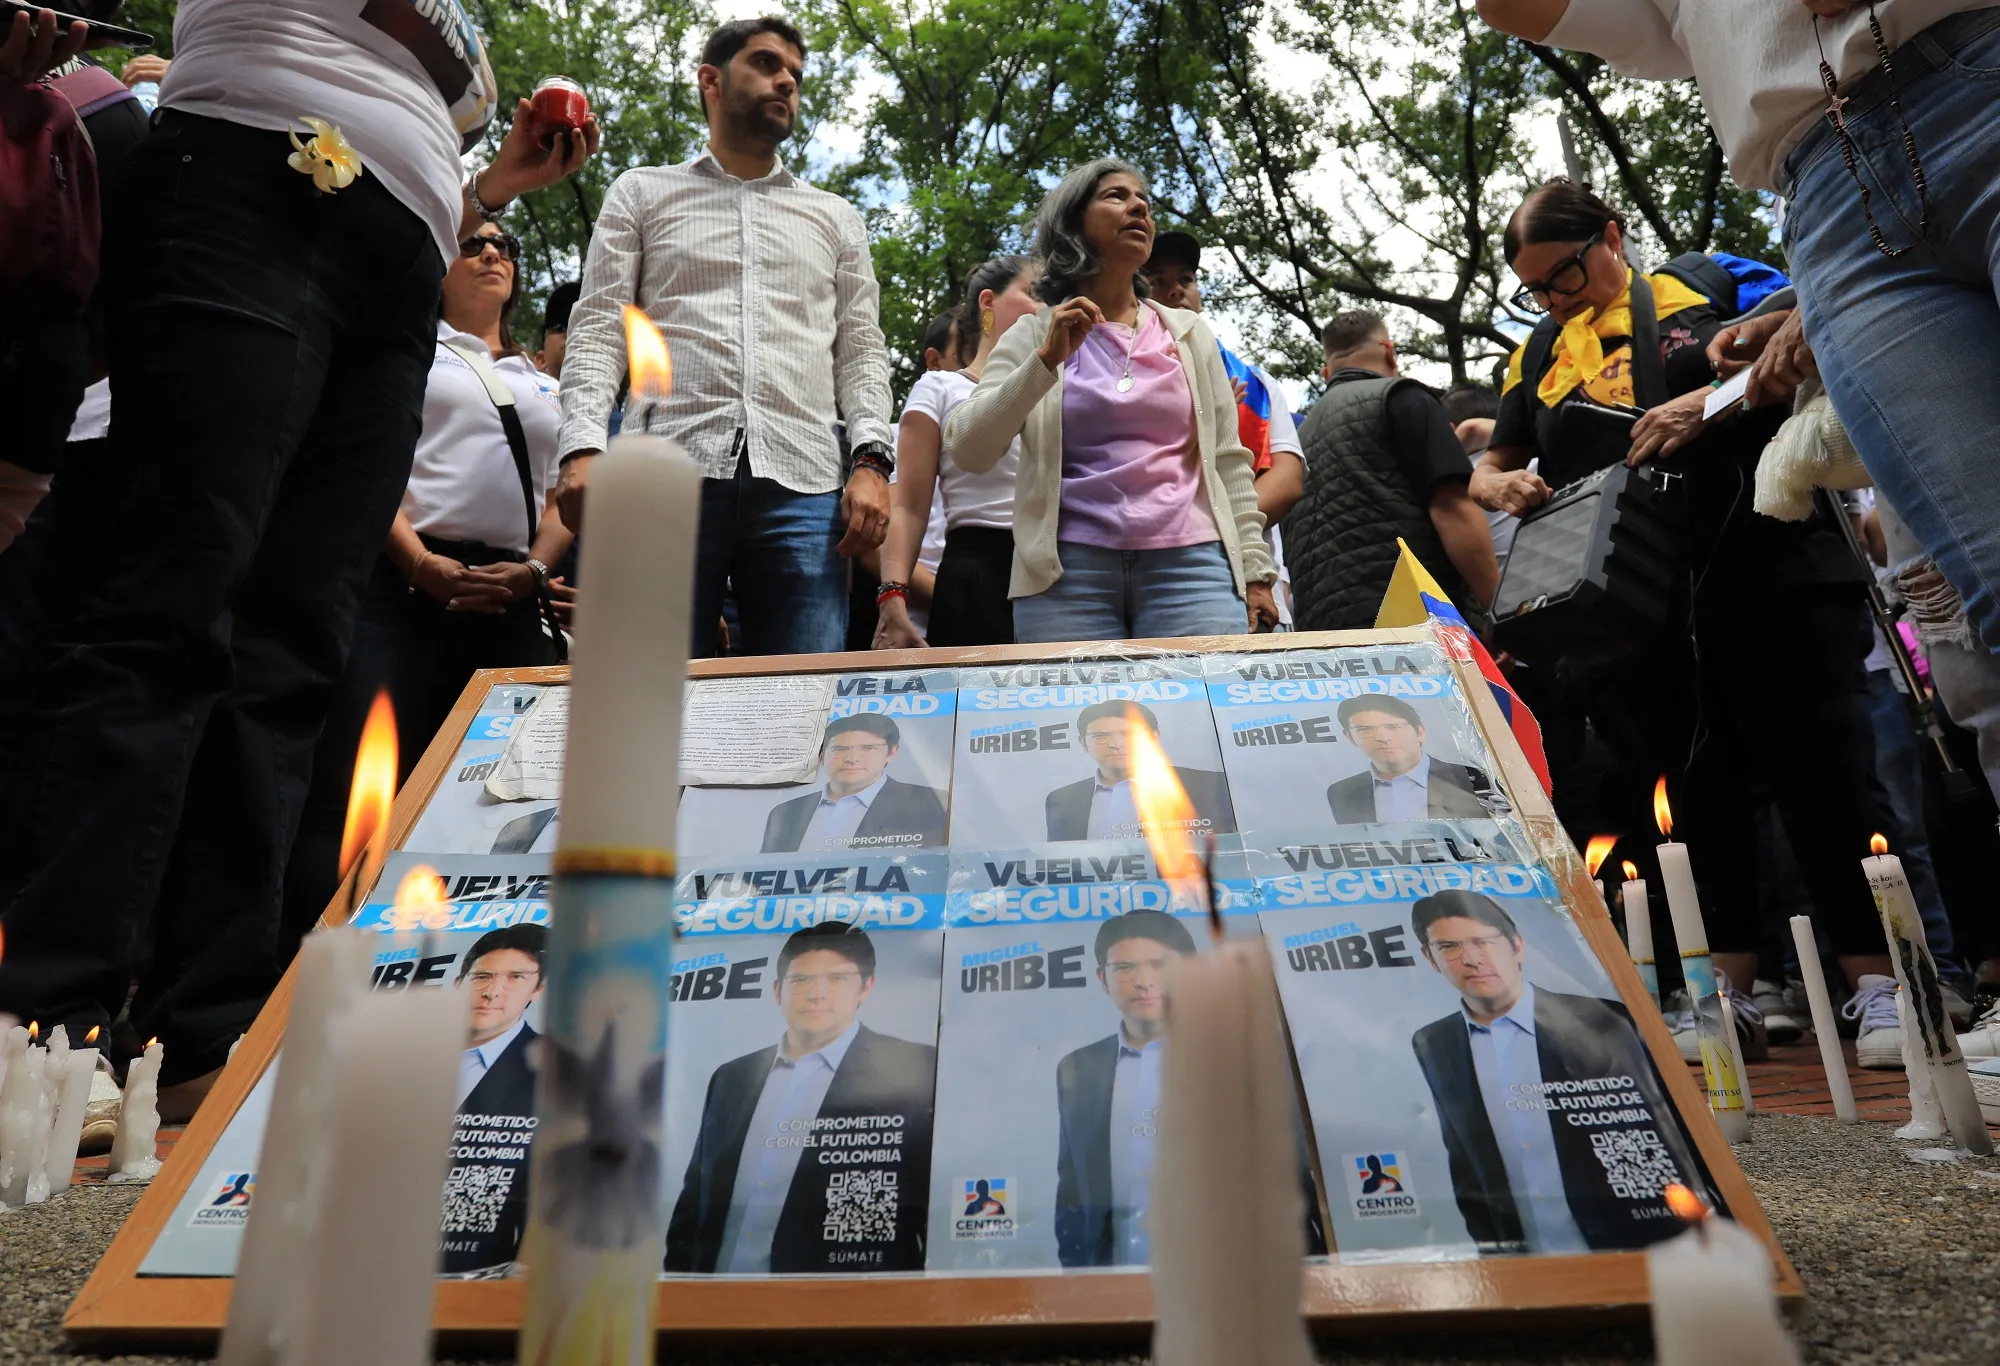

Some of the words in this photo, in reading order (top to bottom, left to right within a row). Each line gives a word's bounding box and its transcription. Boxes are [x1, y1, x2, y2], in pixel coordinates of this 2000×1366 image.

[988, 666, 1121, 688] VUELVE
[1232, 658, 1370, 682] VUELVE
[1371, 655, 1421, 676] LA
[883, 675, 927, 694] LA
[1226, 676, 1442, 704] SEGURIDAD
[830, 694, 939, 718] RIDAD
[975, 681, 1189, 710] SEGURIDAD
[970, 720, 1036, 737] MIGUEL
[1231, 713, 1296, 731] MIGUEL
[1233, 715, 1338, 747] URIBE
[969, 722, 1071, 754] URIBE
[824, 833, 923, 846] COMPROMETIDO
[1277, 838, 1444, 873] VUELVE
[984, 854, 1149, 887] VUELVE
[694, 866, 849, 900] VUELVE
[855, 865, 910, 893] LA
[1274, 865, 1534, 906] SEGURIDAD
[968, 881, 1232, 924] SEGURIDAD
[371, 902, 554, 931] SEGURID
[673, 896, 925, 934] SEGURIDAD
[1283, 921, 1363, 950] MIGUEL
[961, 941, 1044, 967] MIGUEL
[1286, 925, 1416, 973] URIBE
[673, 952, 729, 972] GUEL
[961, 945, 1087, 994] URIBE
[1509, 1075, 1635, 1096] COMPROMETIDO
[1505, 1099, 1541, 1111] CON
[1543, 1098, 1560, 1111] EL
[1560, 1094, 1621, 1110] FUTURO
[1620, 1091, 1644, 1105] DE
[452, 1113, 540, 1129] PROMETIDO
[779, 1115, 905, 1132] COMPROMETIDO
[1567, 1108, 1652, 1126] COLOMBIA
[452, 1129, 511, 1144] FUTURO
[511, 1131, 534, 1144] DE
[764, 1136, 800, 1149] CON
[802, 1136, 818, 1148] EL
[820, 1132, 880, 1147] FUTURO
[882, 1131, 904, 1145] DE
[447, 1147, 525, 1160] COLOMBIA
[818, 1148, 902, 1164] COLOMBIA
[1356, 1195, 1415, 1209] CENTRO
[197, 1209, 250, 1219] CENTRO
[956, 1218, 1013, 1231] CENTRO
[441, 1240, 480, 1253] MATE
